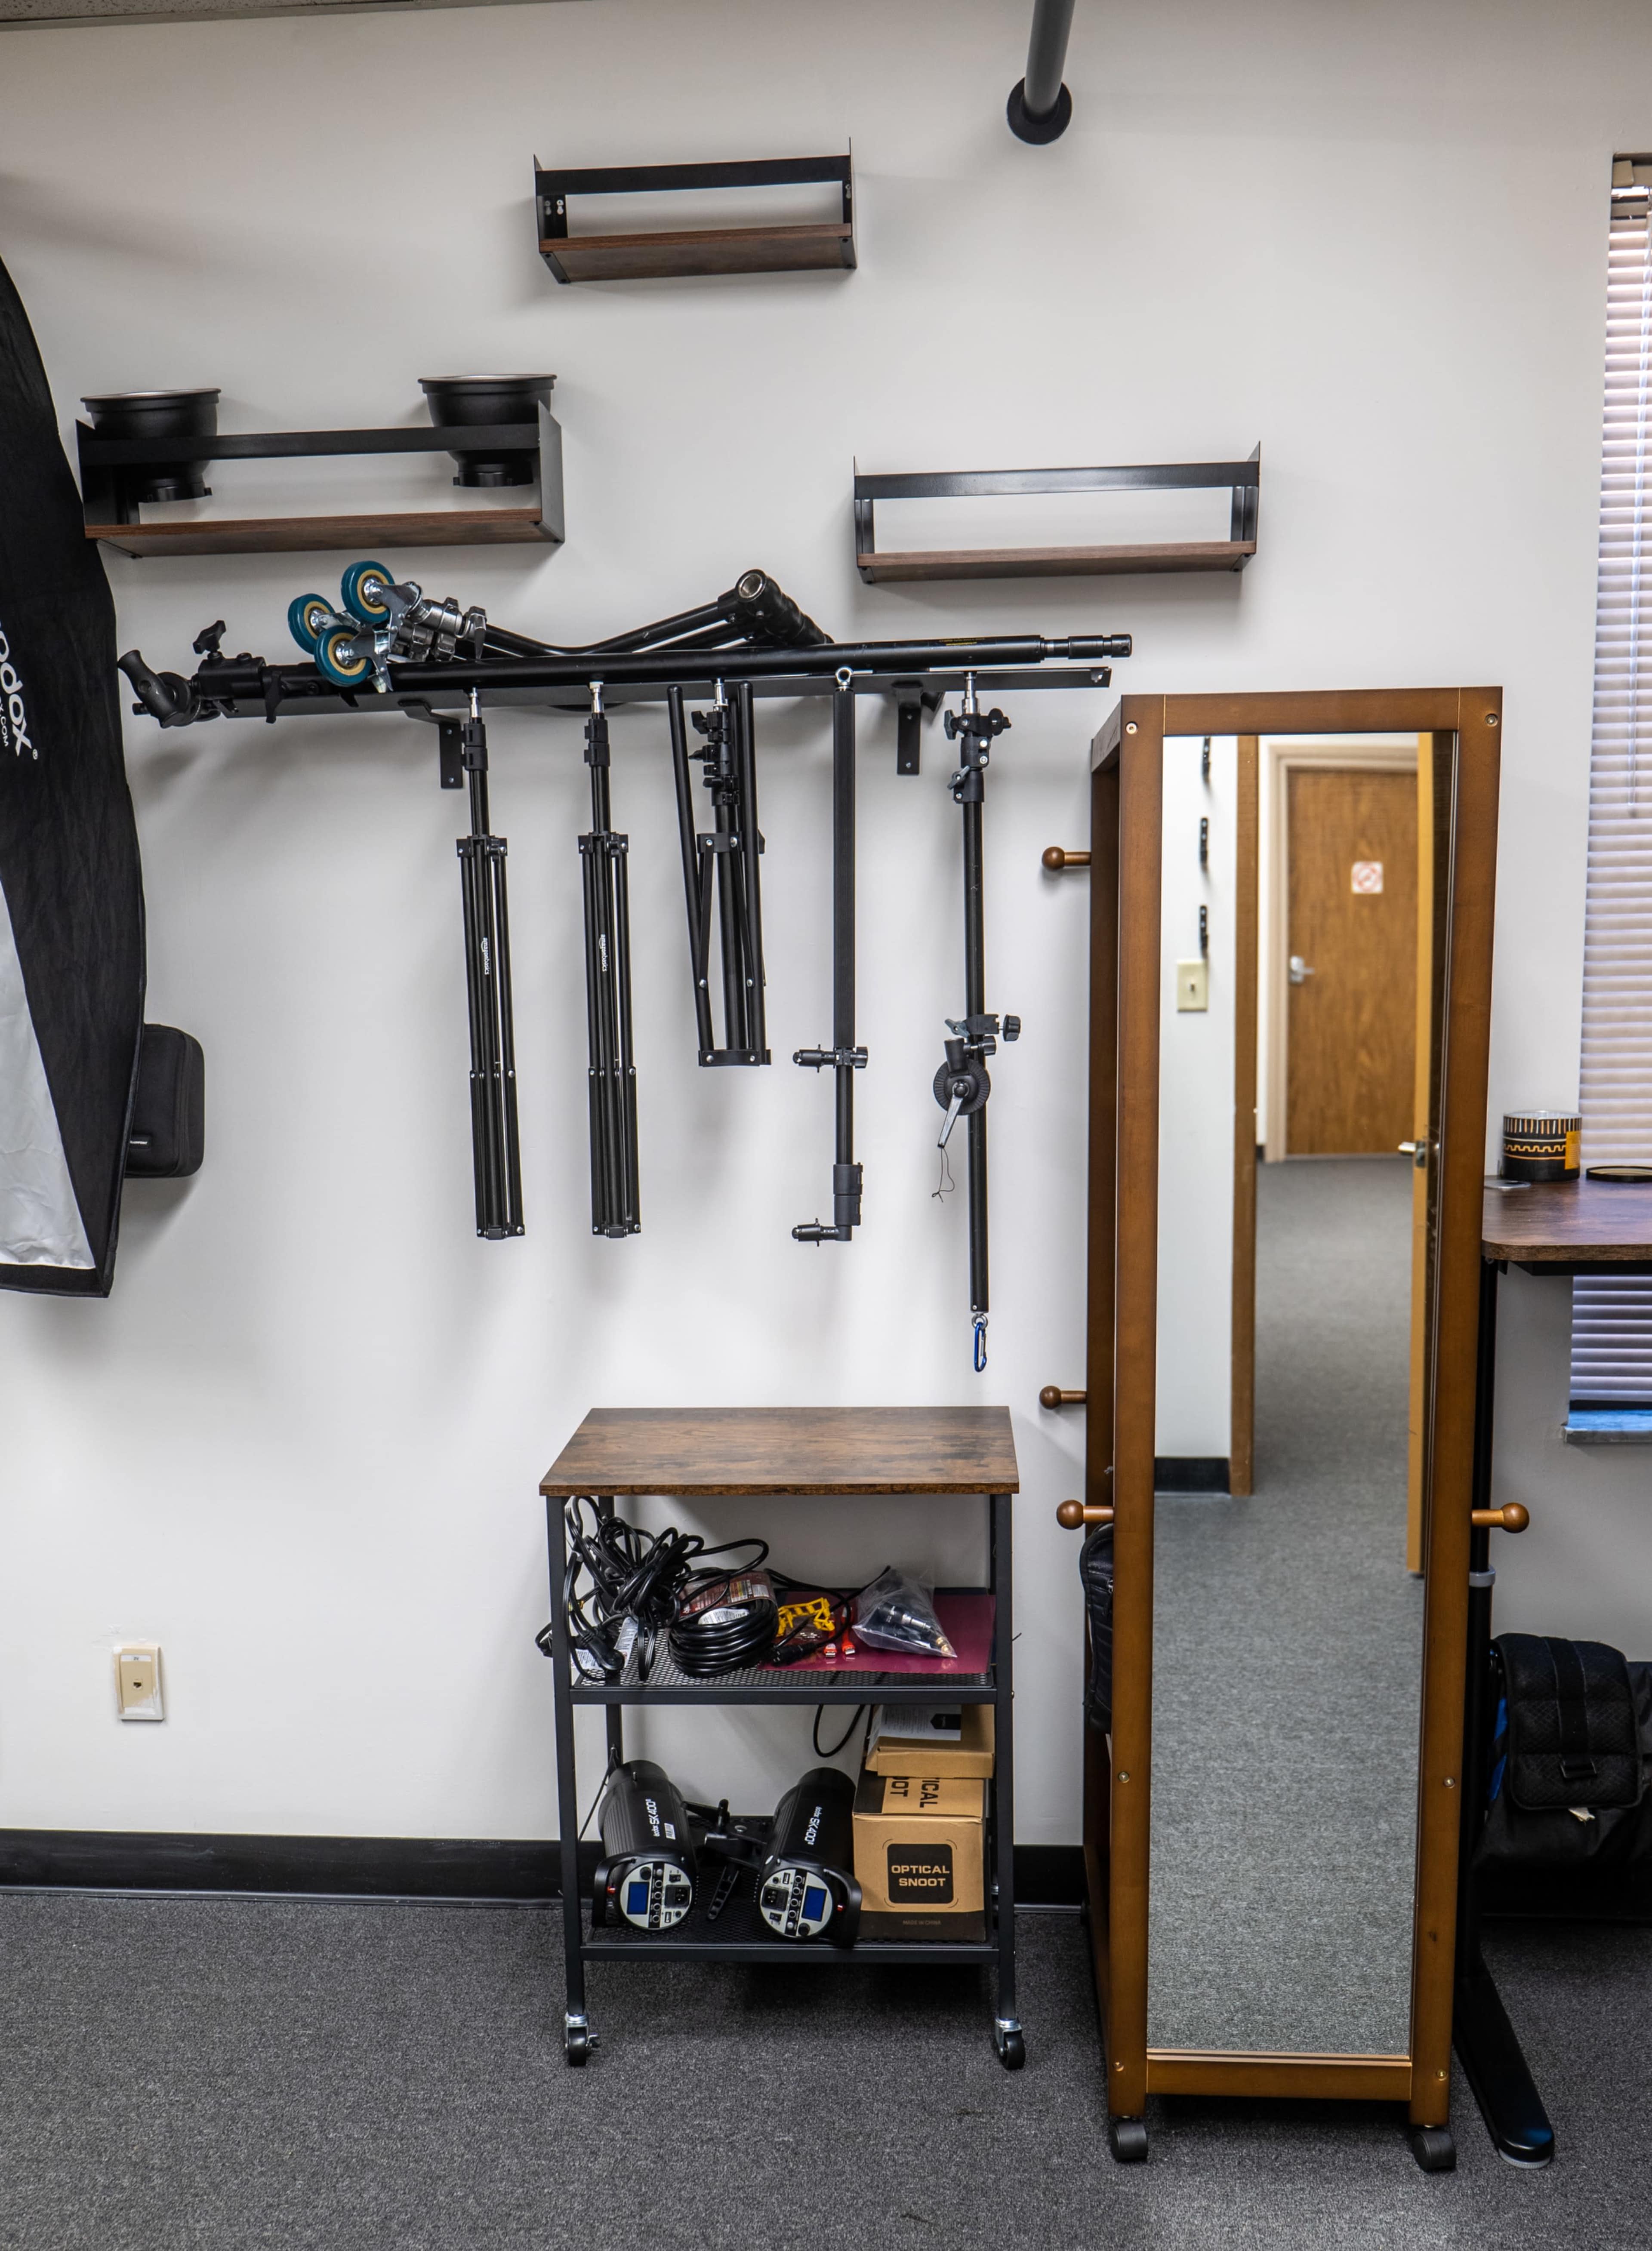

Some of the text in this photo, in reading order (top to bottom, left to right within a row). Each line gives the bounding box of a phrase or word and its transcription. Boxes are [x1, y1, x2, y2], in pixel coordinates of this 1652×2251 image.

[0, 621, 32, 756] odox
[919, 1778, 940, 1808] ICAL
[891, 1865, 949, 1874] OPTICAL
[899, 1878, 946, 1887] SNOOT
